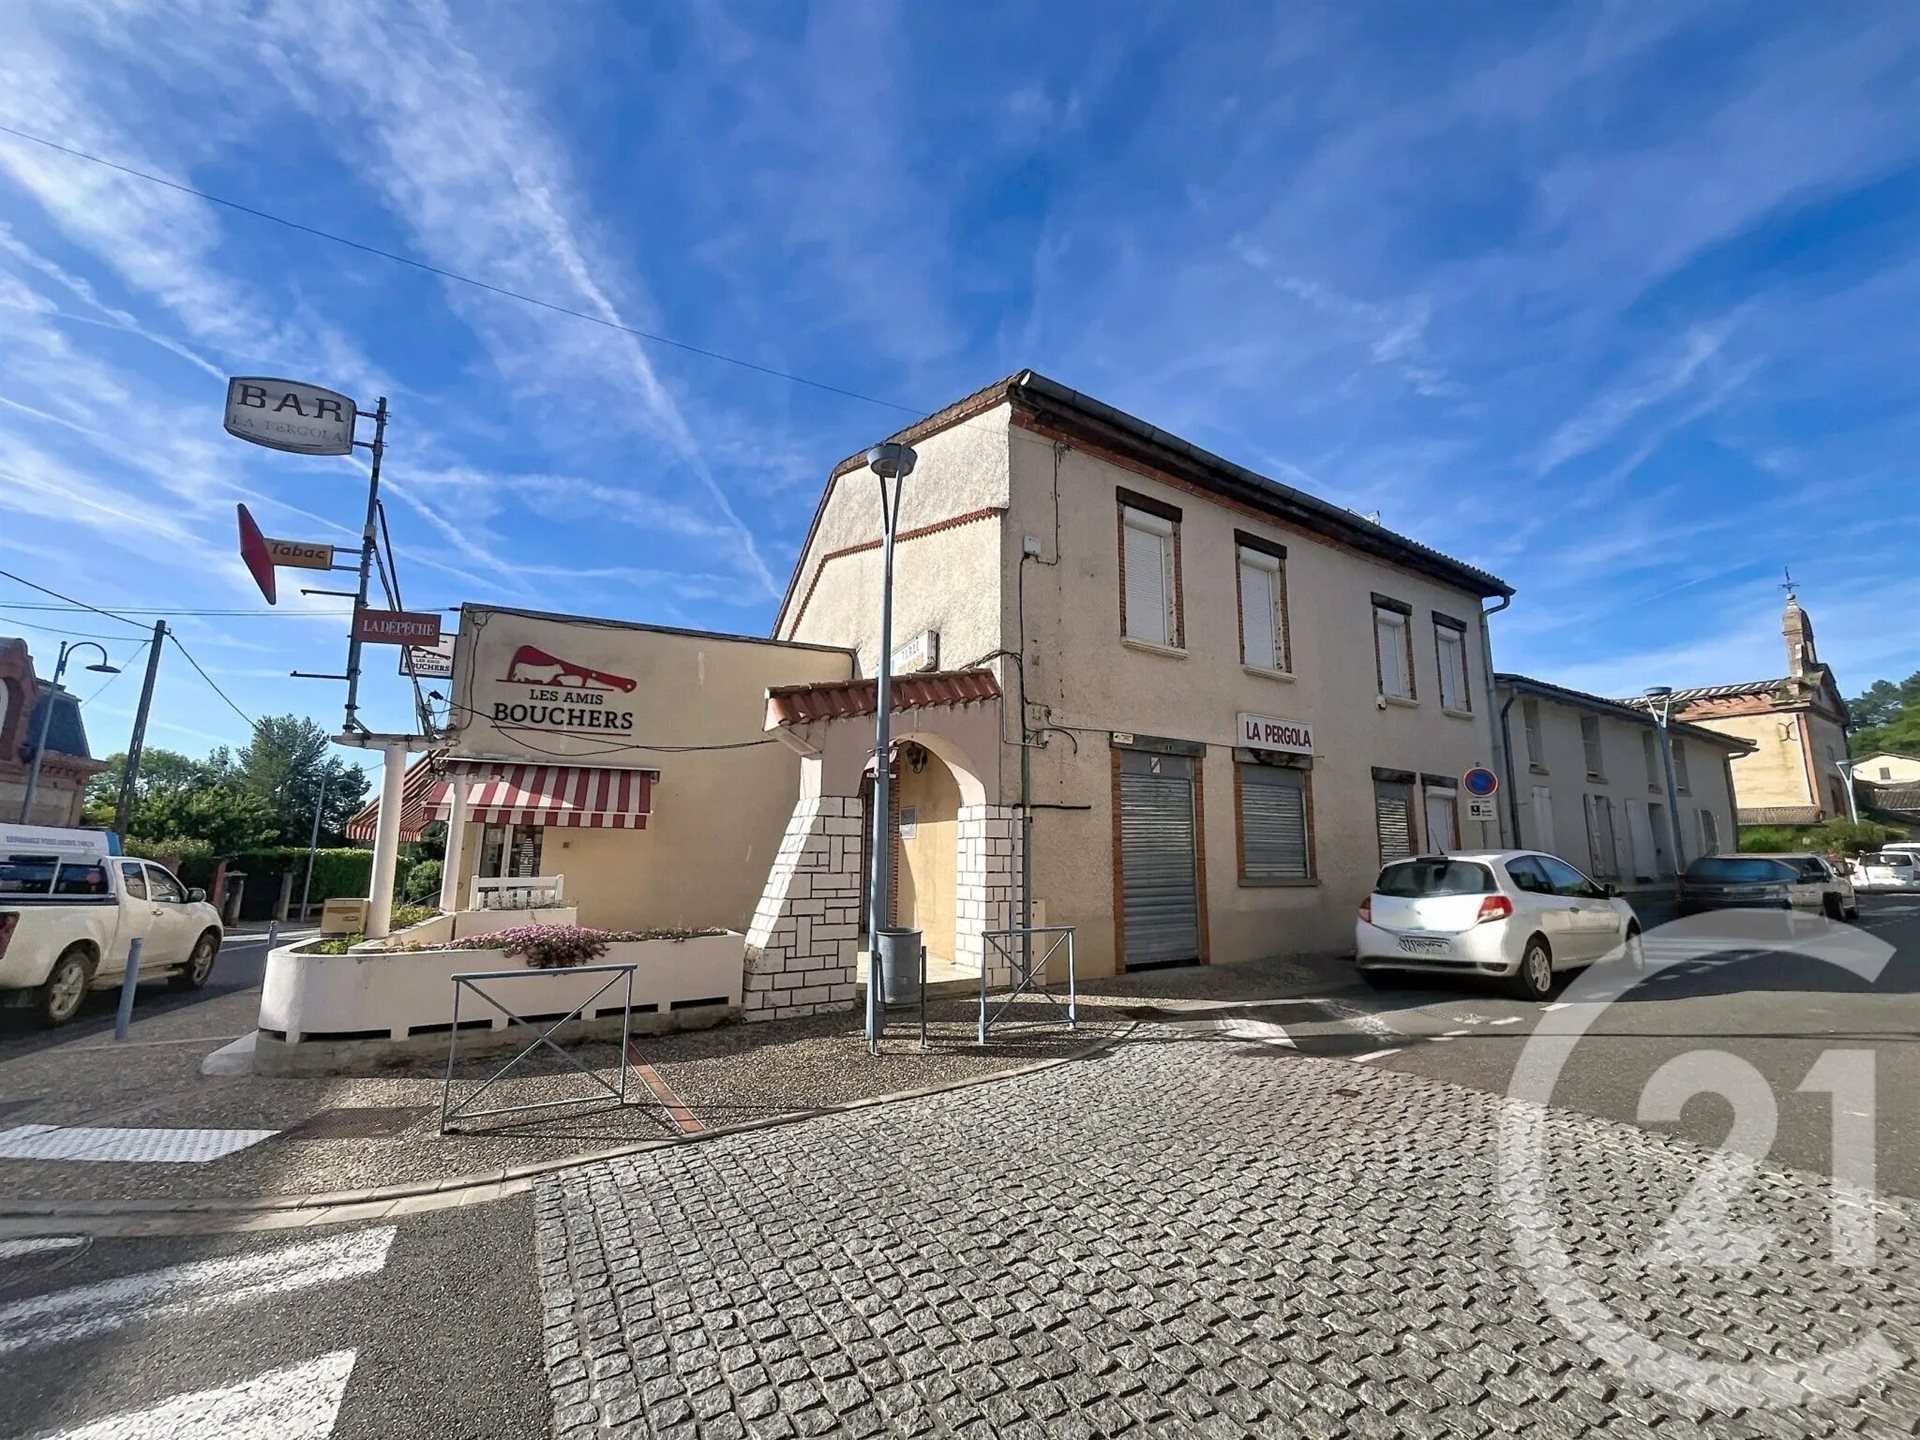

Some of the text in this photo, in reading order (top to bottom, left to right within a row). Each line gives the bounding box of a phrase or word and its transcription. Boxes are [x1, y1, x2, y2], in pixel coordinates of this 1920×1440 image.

[237, 384, 344, 422] BAR
[270, 542, 326, 559] Tabac
[363, 619, 379, 632] LA
[529, 688, 604, 705] LES AMIS
[494, 702, 634, 730] BOUCHERS
[1246, 721, 1312, 748] LA PERGOLA
